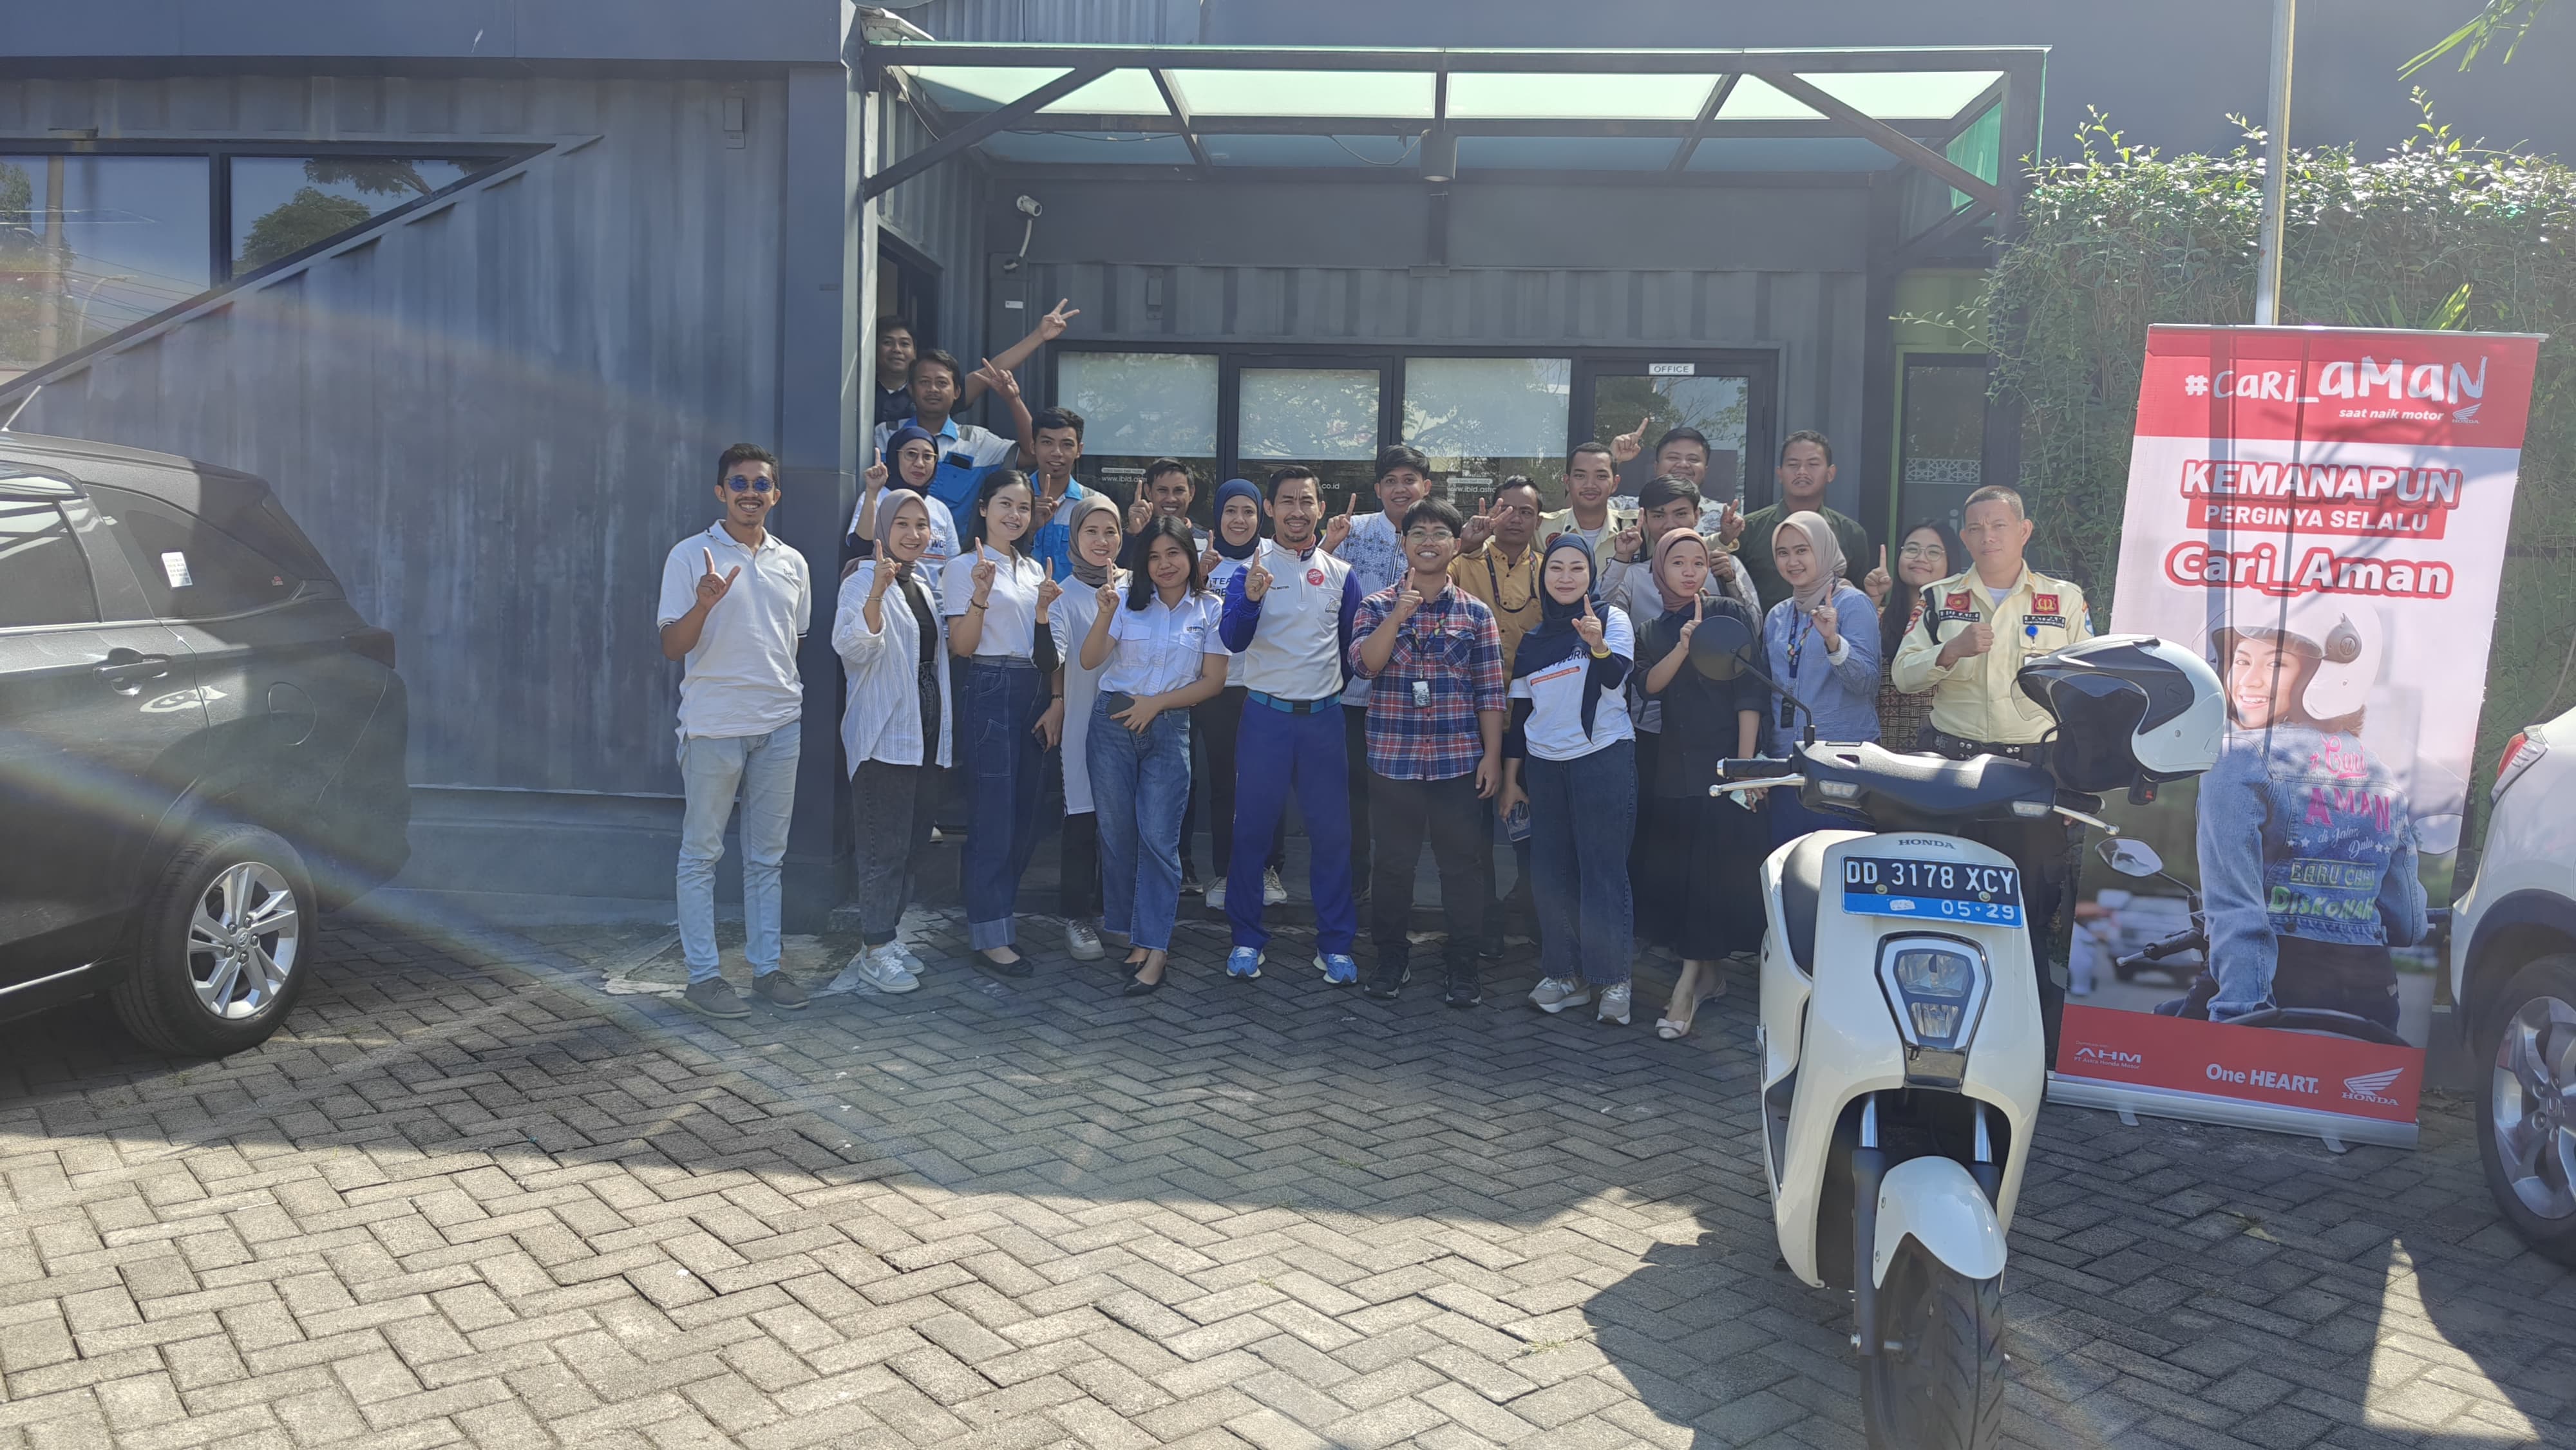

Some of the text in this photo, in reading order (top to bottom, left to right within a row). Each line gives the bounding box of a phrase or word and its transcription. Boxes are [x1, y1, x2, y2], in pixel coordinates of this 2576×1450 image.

[2339, 408, 2444, 420] saat naik motor
[2183, 461, 2461, 504] KEMANAPUN
[2204, 505, 2429, 532] PERGINYA SELALU
[2172, 545, 2447, 594] Cari_Aman
[2303, 787, 2391, 834] AMAN
[1899, 839, 1956, 850] HONDA
[2318, 829, 2329, 843] di
[2349, 836, 2374, 859] Dulu
[1846, 861, 2014, 894] DD 3178 XCY
[2290, 862, 2343, 885] BARU
[2075, 1047, 2142, 1063] AHM
[2206, 1064, 2246, 1084] One
[2341, 1091, 2400, 1106] HONDA
